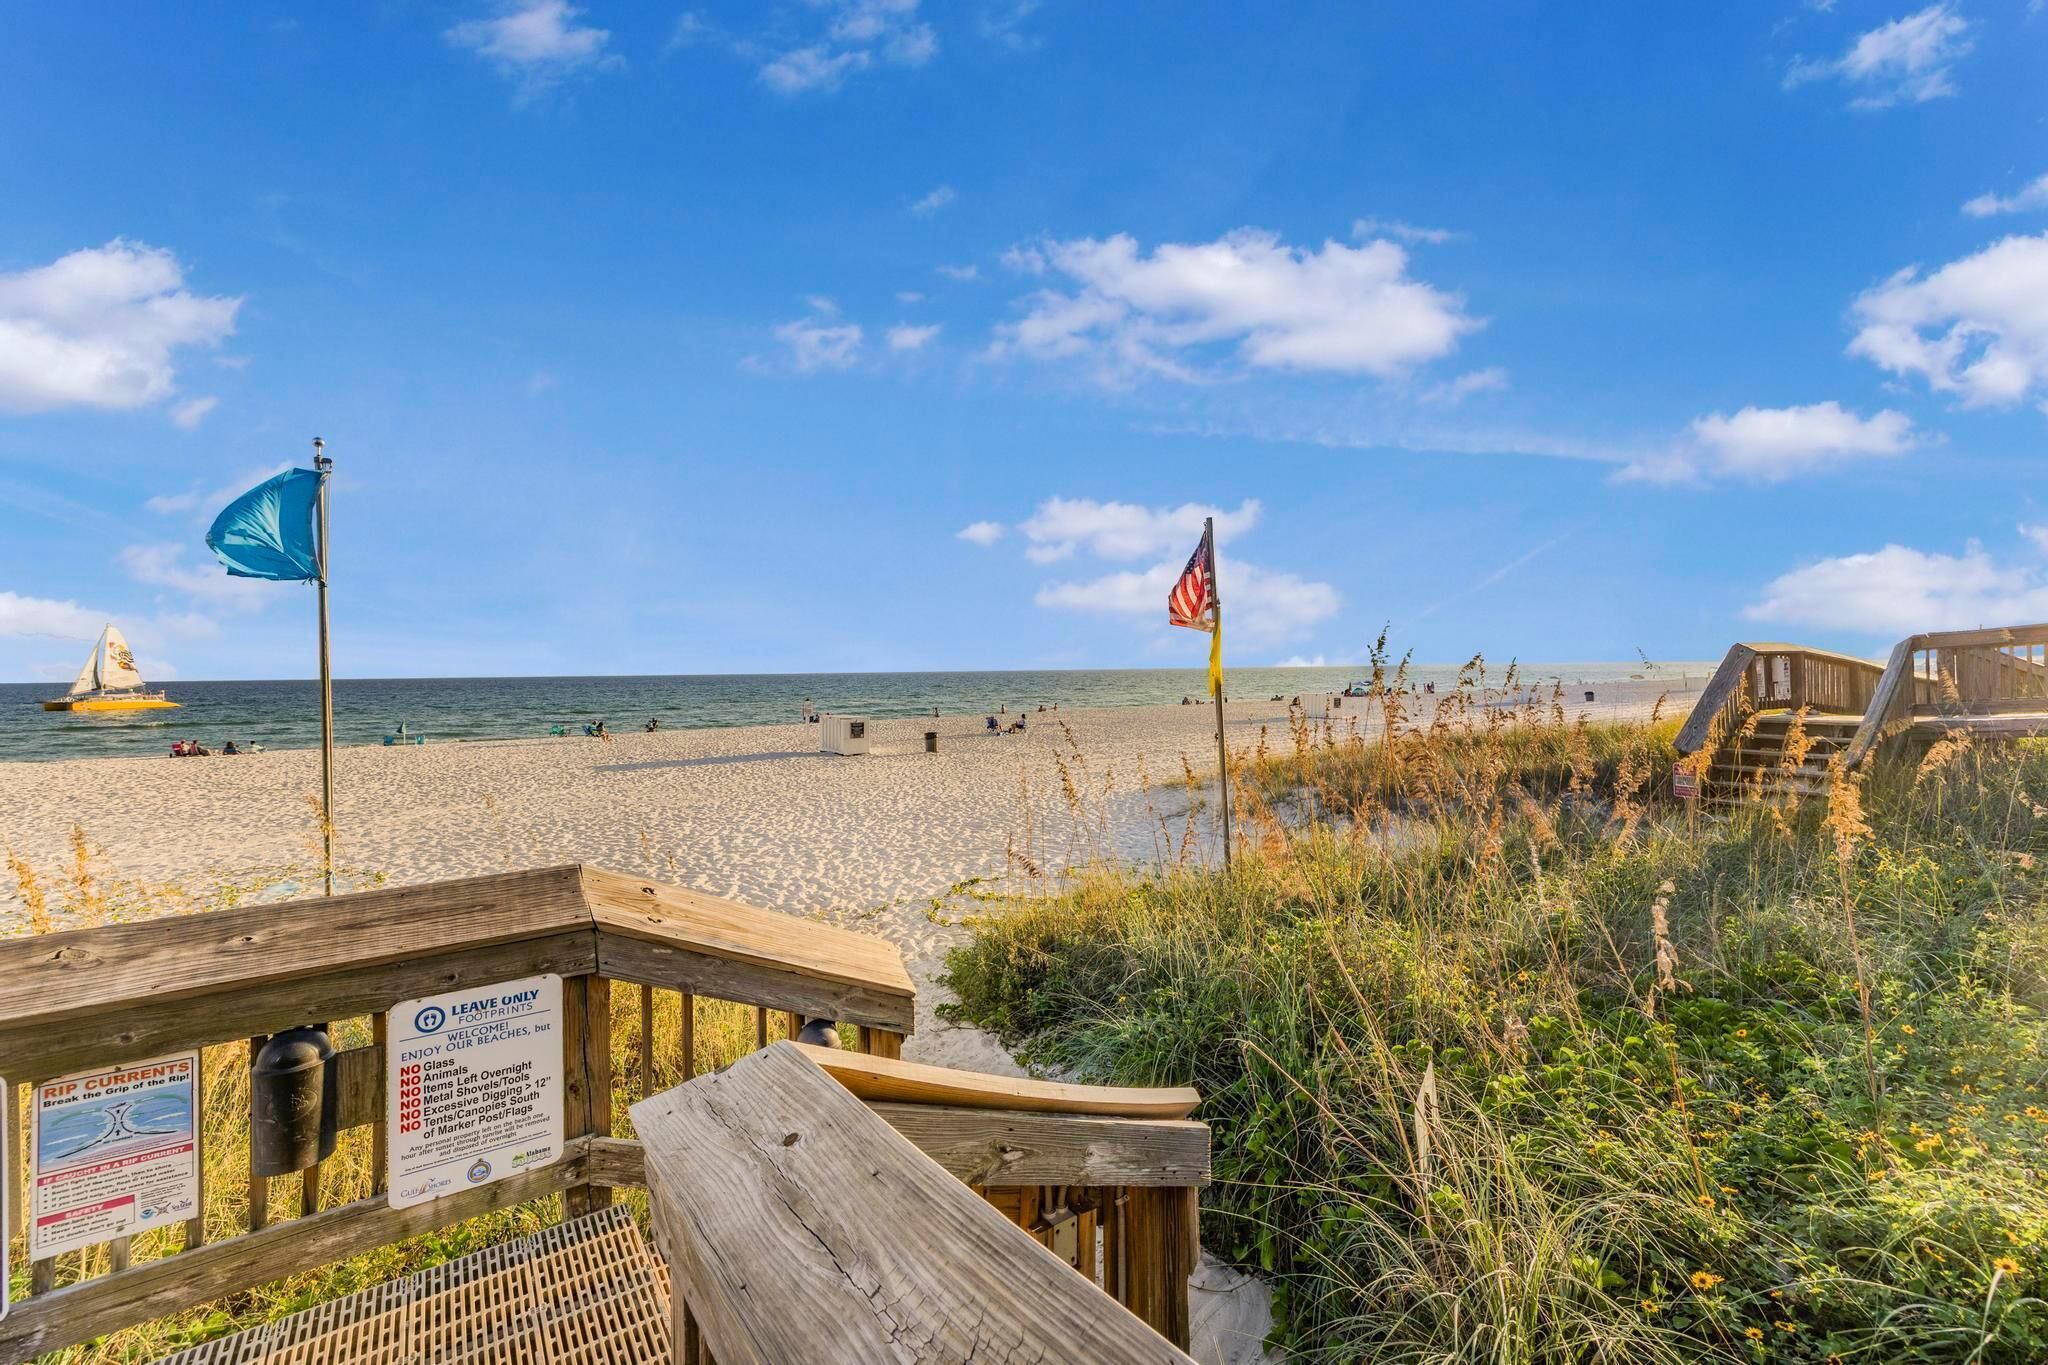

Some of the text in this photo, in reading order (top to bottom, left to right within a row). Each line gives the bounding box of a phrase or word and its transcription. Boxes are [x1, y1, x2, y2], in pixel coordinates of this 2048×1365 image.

[451, 989, 540, 1017] LEAVE ONLY
[458, 1001, 533, 1025] FOOTPRINTS
[401, 1022, 551, 1062] ENJOY OUR BEACHES, but
[447, 1021, 509, 1042] WELCOME!
[44, 1061, 190, 1099] RIP CURRENTS
[400, 1058, 455, 1077] NO Glass
[400, 1065, 469, 1088] NO Animals
[400, 1060, 532, 1100] NO Items Left Overnight
[43, 1072, 190, 1108] Break the Grip of the Rip!
[400, 1072, 530, 1111] NO Metal Shovels/Tools
[400, 1109, 421, 1122] NO
[423, 1096, 479, 1117] Excessive
[482, 1085, 522, 1102] Digging
[400, 1090, 540, 1134] NO Tents/Canopies South
[423, 1104, 533, 1139] of Marker Post/Flags
[401, 1152, 417, 1161] hour
[418, 1147, 434, 1156] after
[525, 1115, 551, 1127] removed
[409, 1144, 424, 1153] Any
[425, 1136, 452, 1149] personal
[453, 1130, 480, 1142] property
[482, 1126, 492, 1134] left
[503, 1120, 513, 1128] the
[439, 1149, 451, 1157] and
[452, 1140, 479, 1153] disposed
[488, 1131, 517, 1143] overnight
[55, 1168, 98, 1180] CAUGHT
[99, 1164, 111, 1172] IN
[122, 1157, 139, 1166] RIP
[140, 1146, 185, 1161] CURRENT
